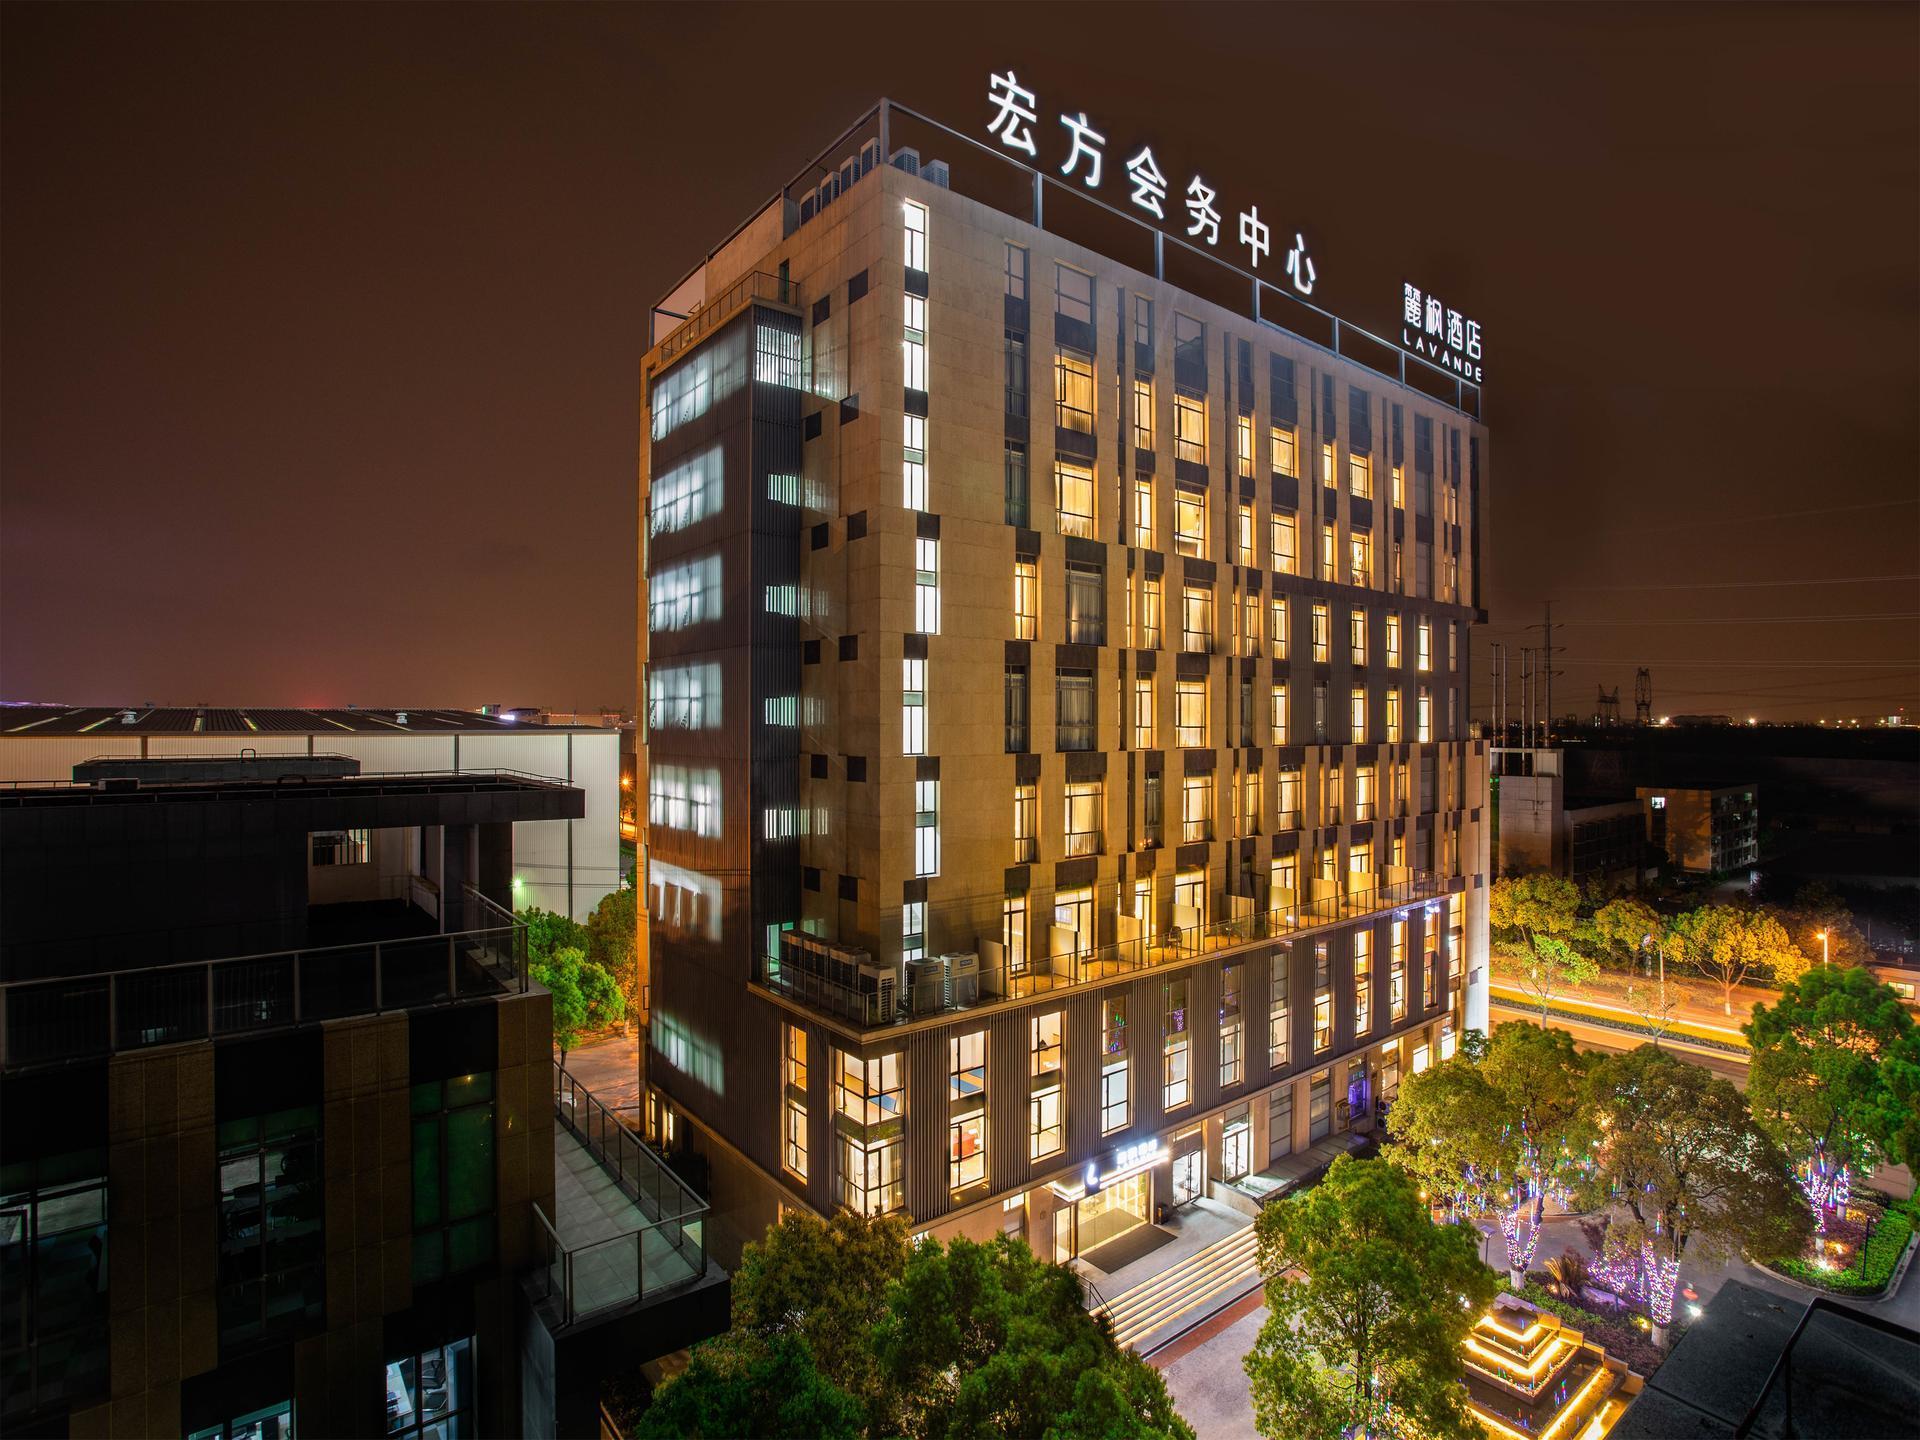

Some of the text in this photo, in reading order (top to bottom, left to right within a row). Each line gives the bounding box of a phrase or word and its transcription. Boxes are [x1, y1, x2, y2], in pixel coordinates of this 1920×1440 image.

[987, 70, 1316, 295] 宏方会务中心
[1404, 328, 1482, 382] LAVANDE
